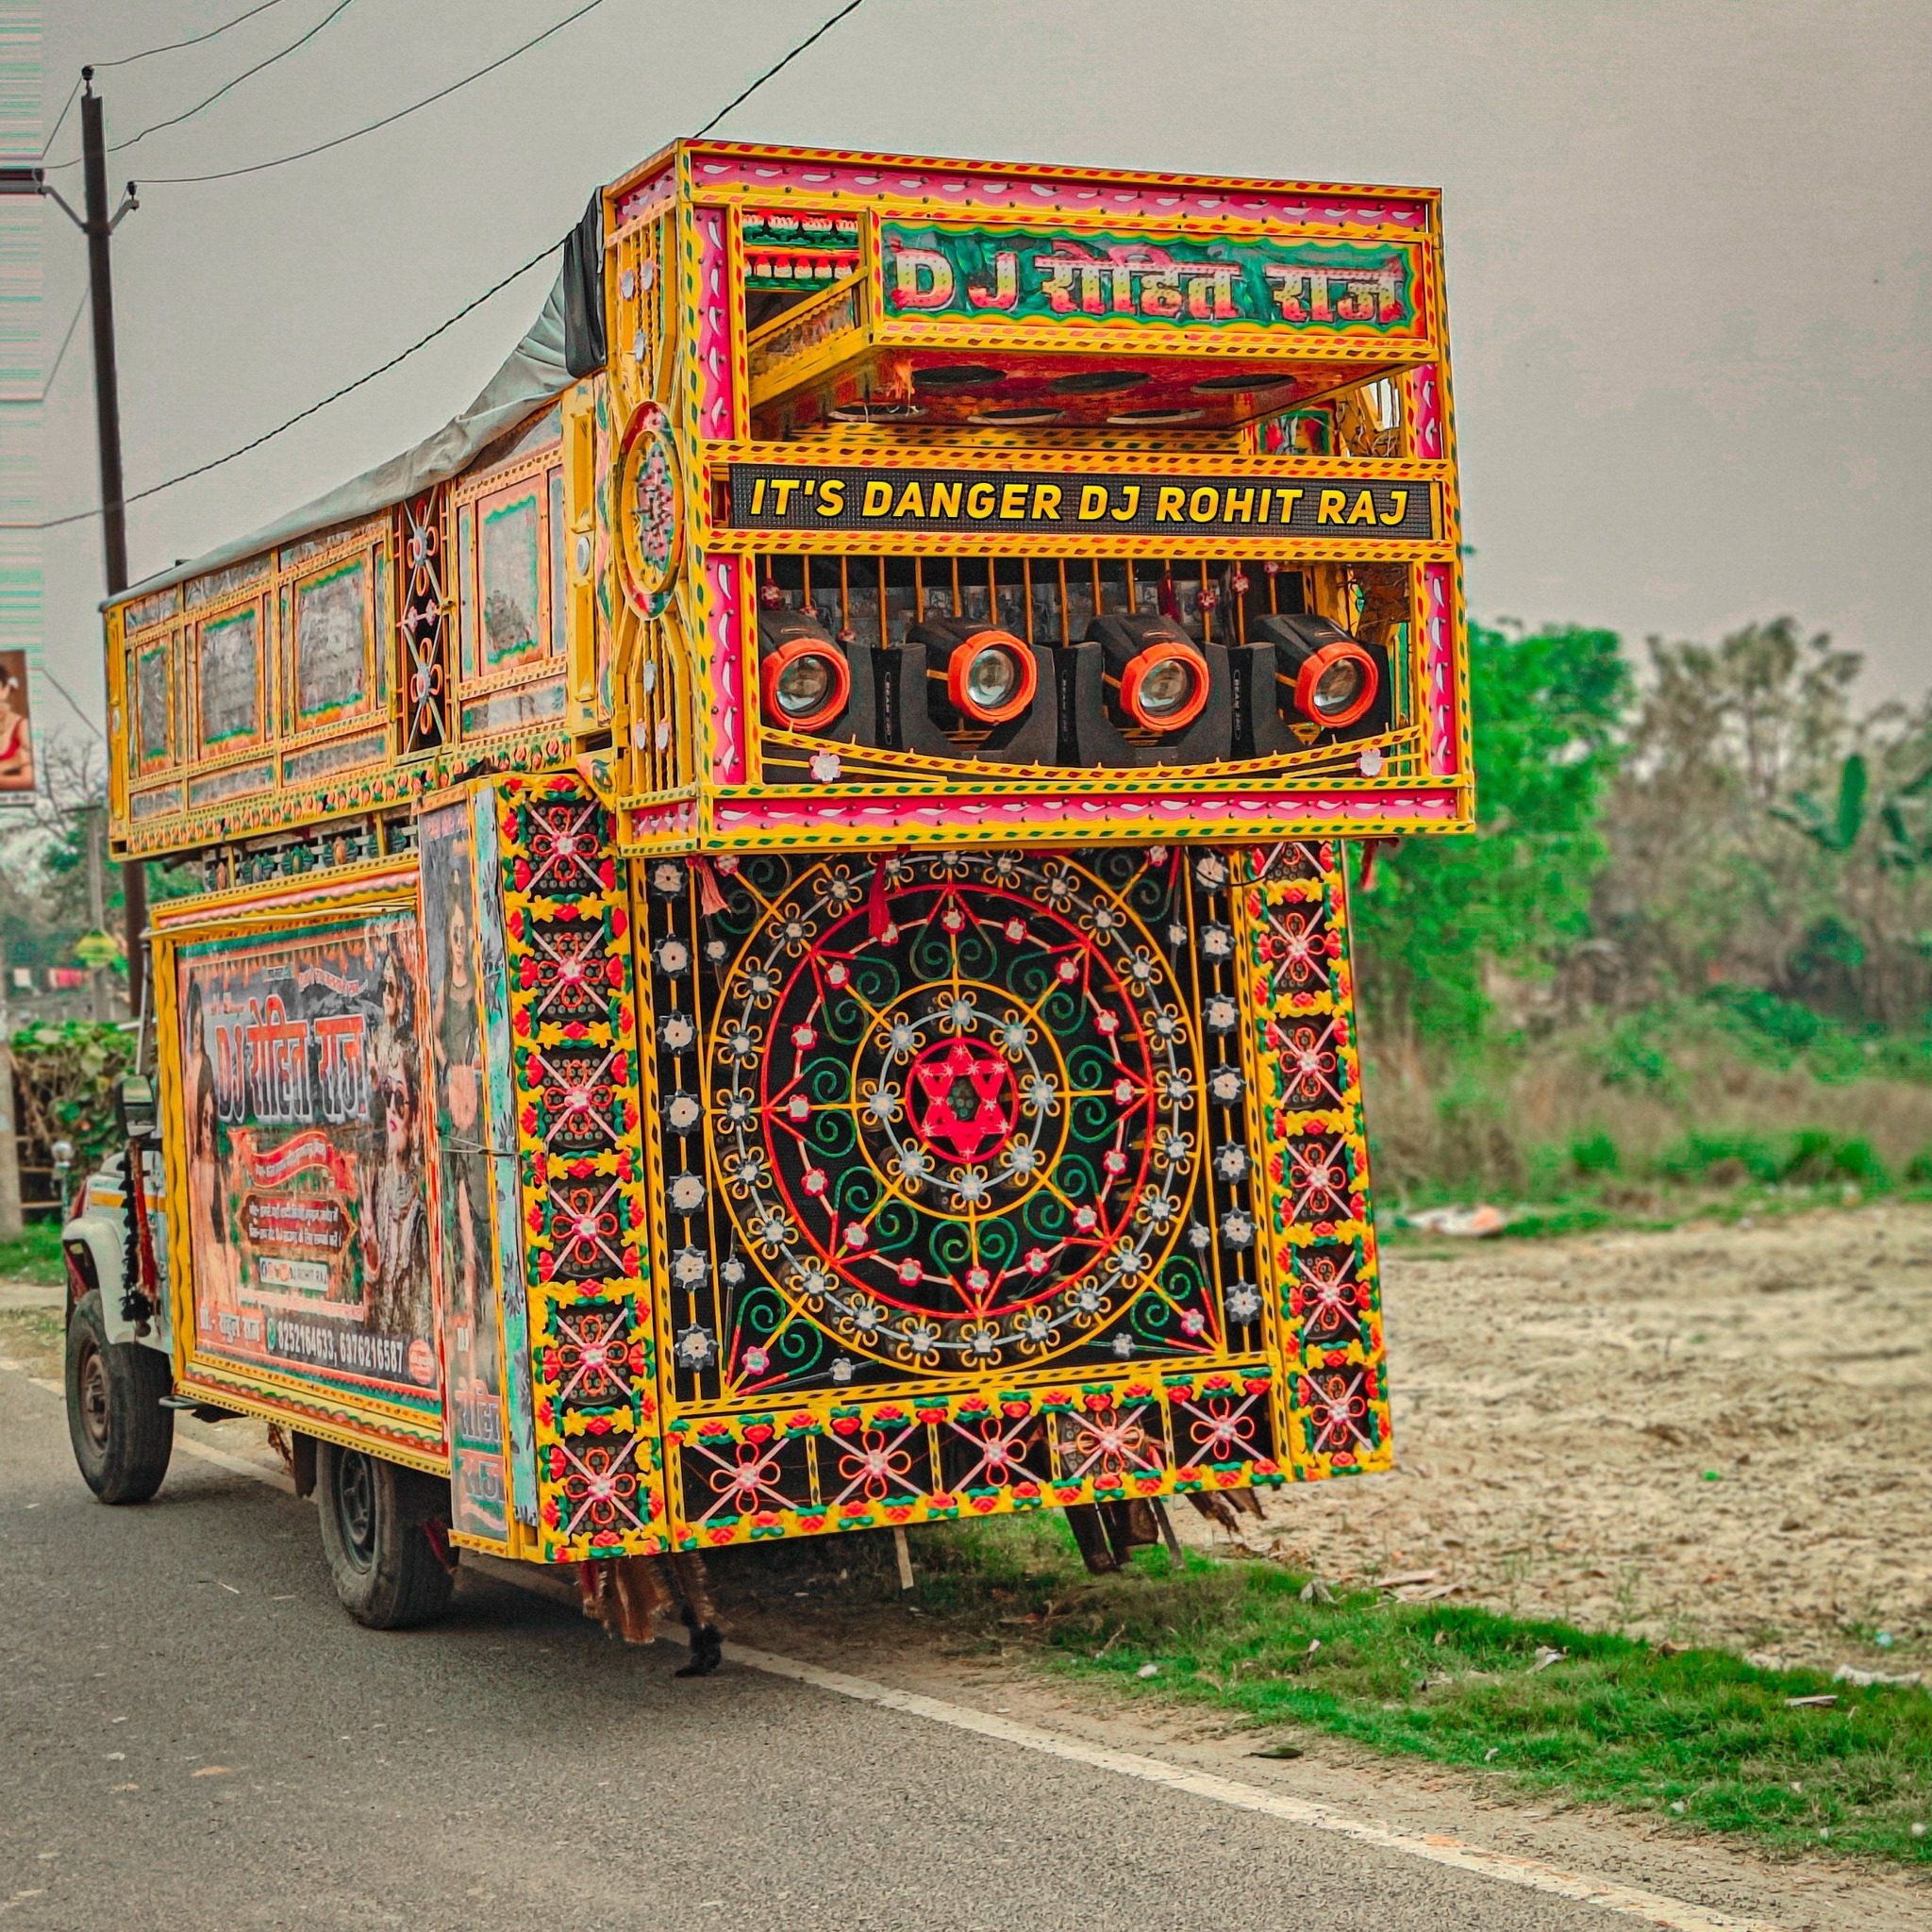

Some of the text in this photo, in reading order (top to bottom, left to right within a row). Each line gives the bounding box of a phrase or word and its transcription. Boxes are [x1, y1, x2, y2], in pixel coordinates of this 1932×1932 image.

[1034, 239, 1242, 322] रोहित
[1264, 257, 1404, 325] राज
[749, 477, 1410, 526] IT'S DANGER DJ ROHIT RAJ
[215, 994, 369, 1123] DJ रोहित राज
